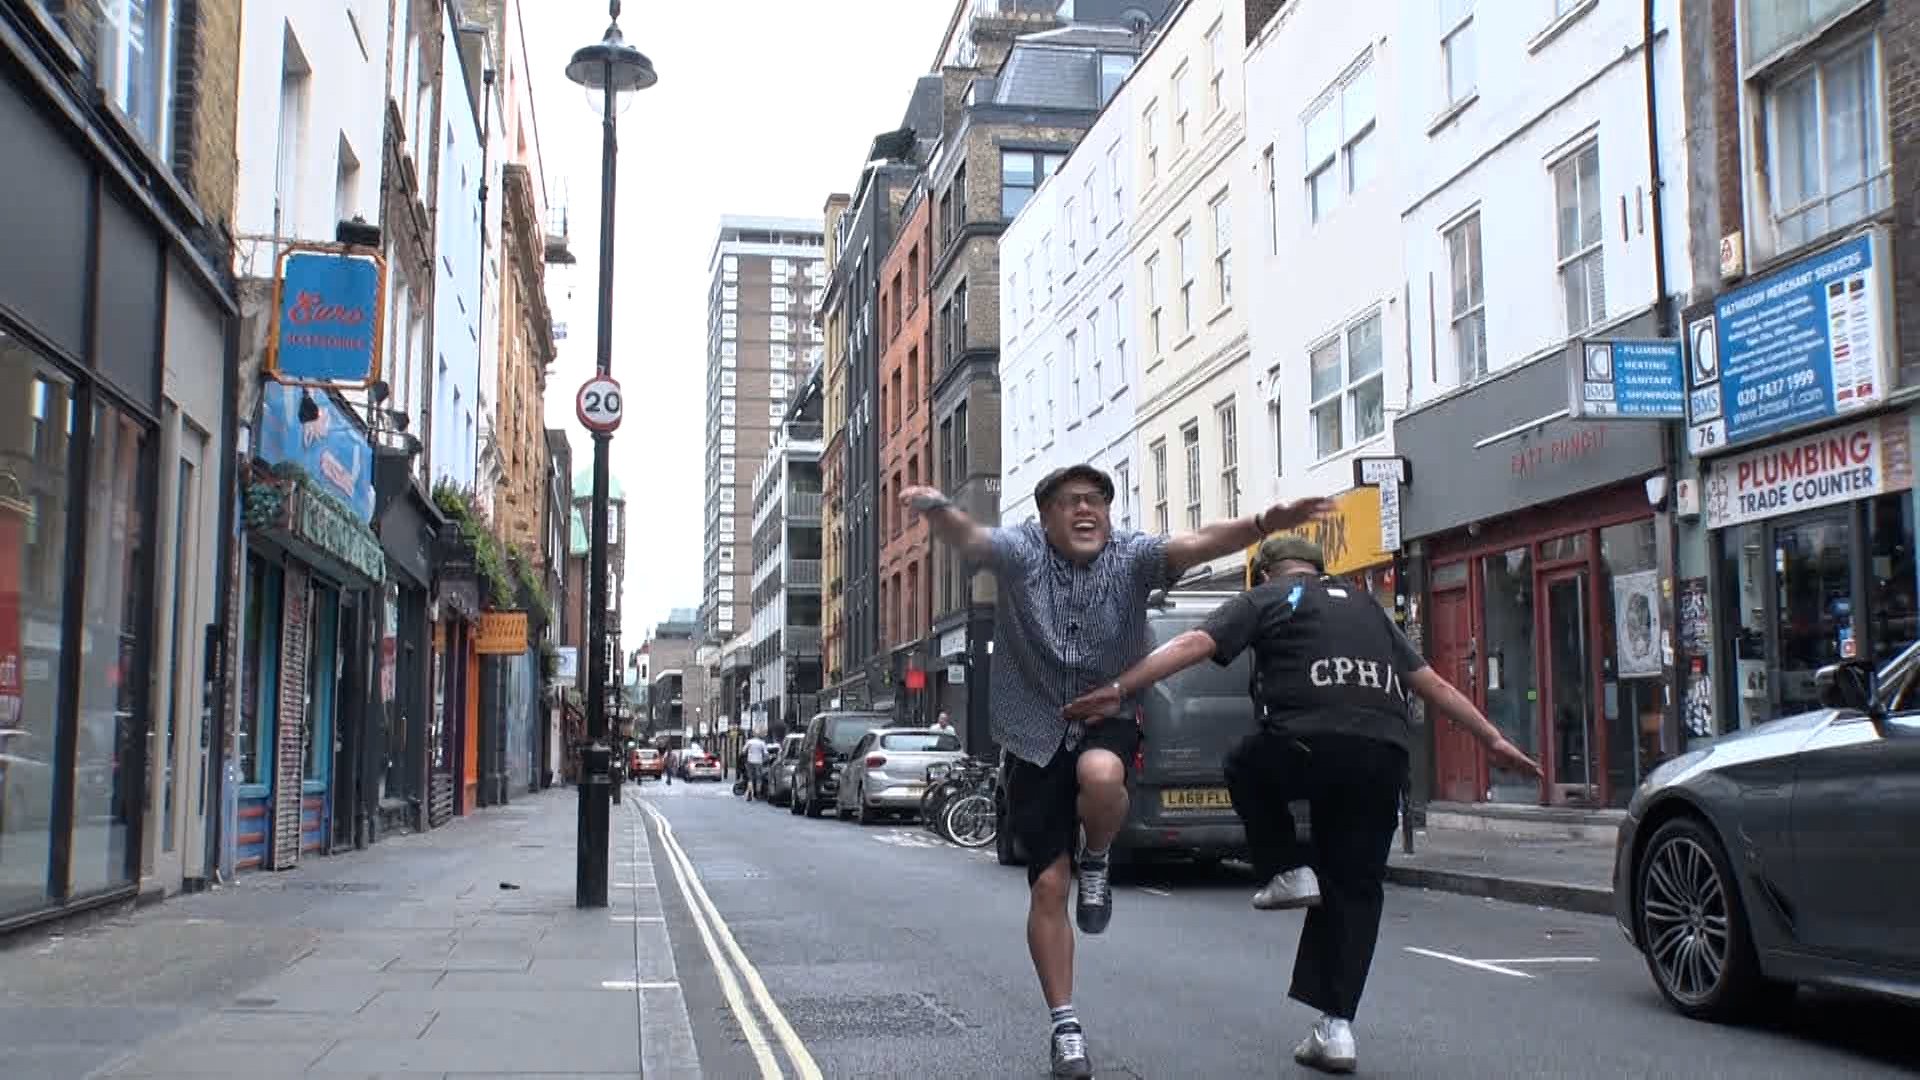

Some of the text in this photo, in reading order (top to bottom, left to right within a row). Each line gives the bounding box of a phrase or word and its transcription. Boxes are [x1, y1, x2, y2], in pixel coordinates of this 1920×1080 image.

[1625, 376, 1674, 385] SANITARY
[585, 391, 620, 414] 20
[1737, 387, 1757, 407] 020
[1698, 425, 1715, 447] 76
[1738, 431, 1872, 491] PLUMBING
[1738, 486, 1787, 514] TRADE
[1792, 467, 1873, 502] COUNTER
